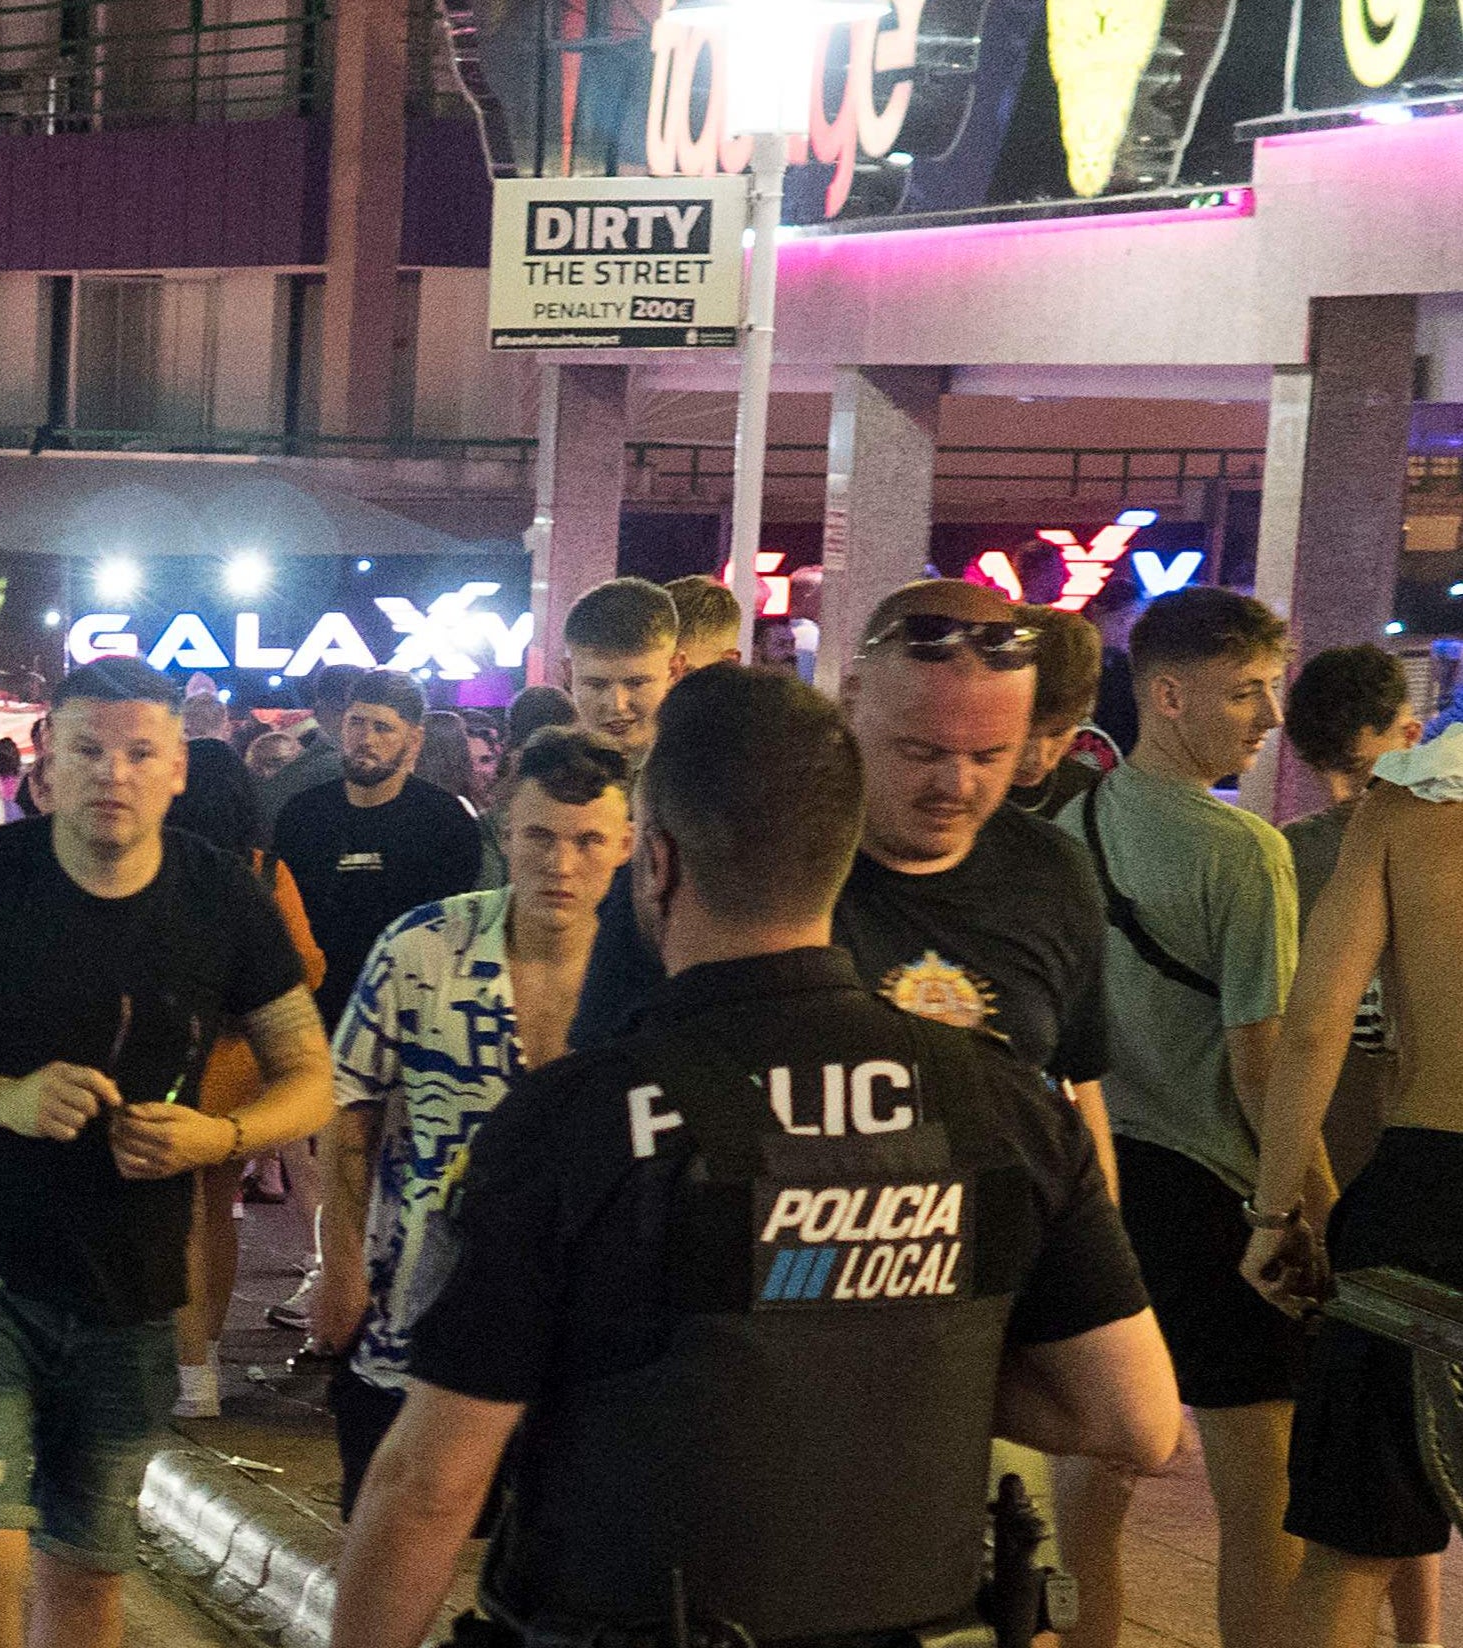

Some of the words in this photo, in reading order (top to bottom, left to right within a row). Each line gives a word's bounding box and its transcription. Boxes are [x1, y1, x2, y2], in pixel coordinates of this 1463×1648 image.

[535, 206, 704, 250] DIRTY
[523, 260, 584, 285] THE
[594, 260, 712, 285] STREET
[533, 301, 625, 320] PENALTY
[634, 299, 694, 321] 200€
[68, 582, 535, 680] GALAXY
[760, 1183, 963, 1243] POLICIA
[833, 1242, 962, 1299] LOCAL
